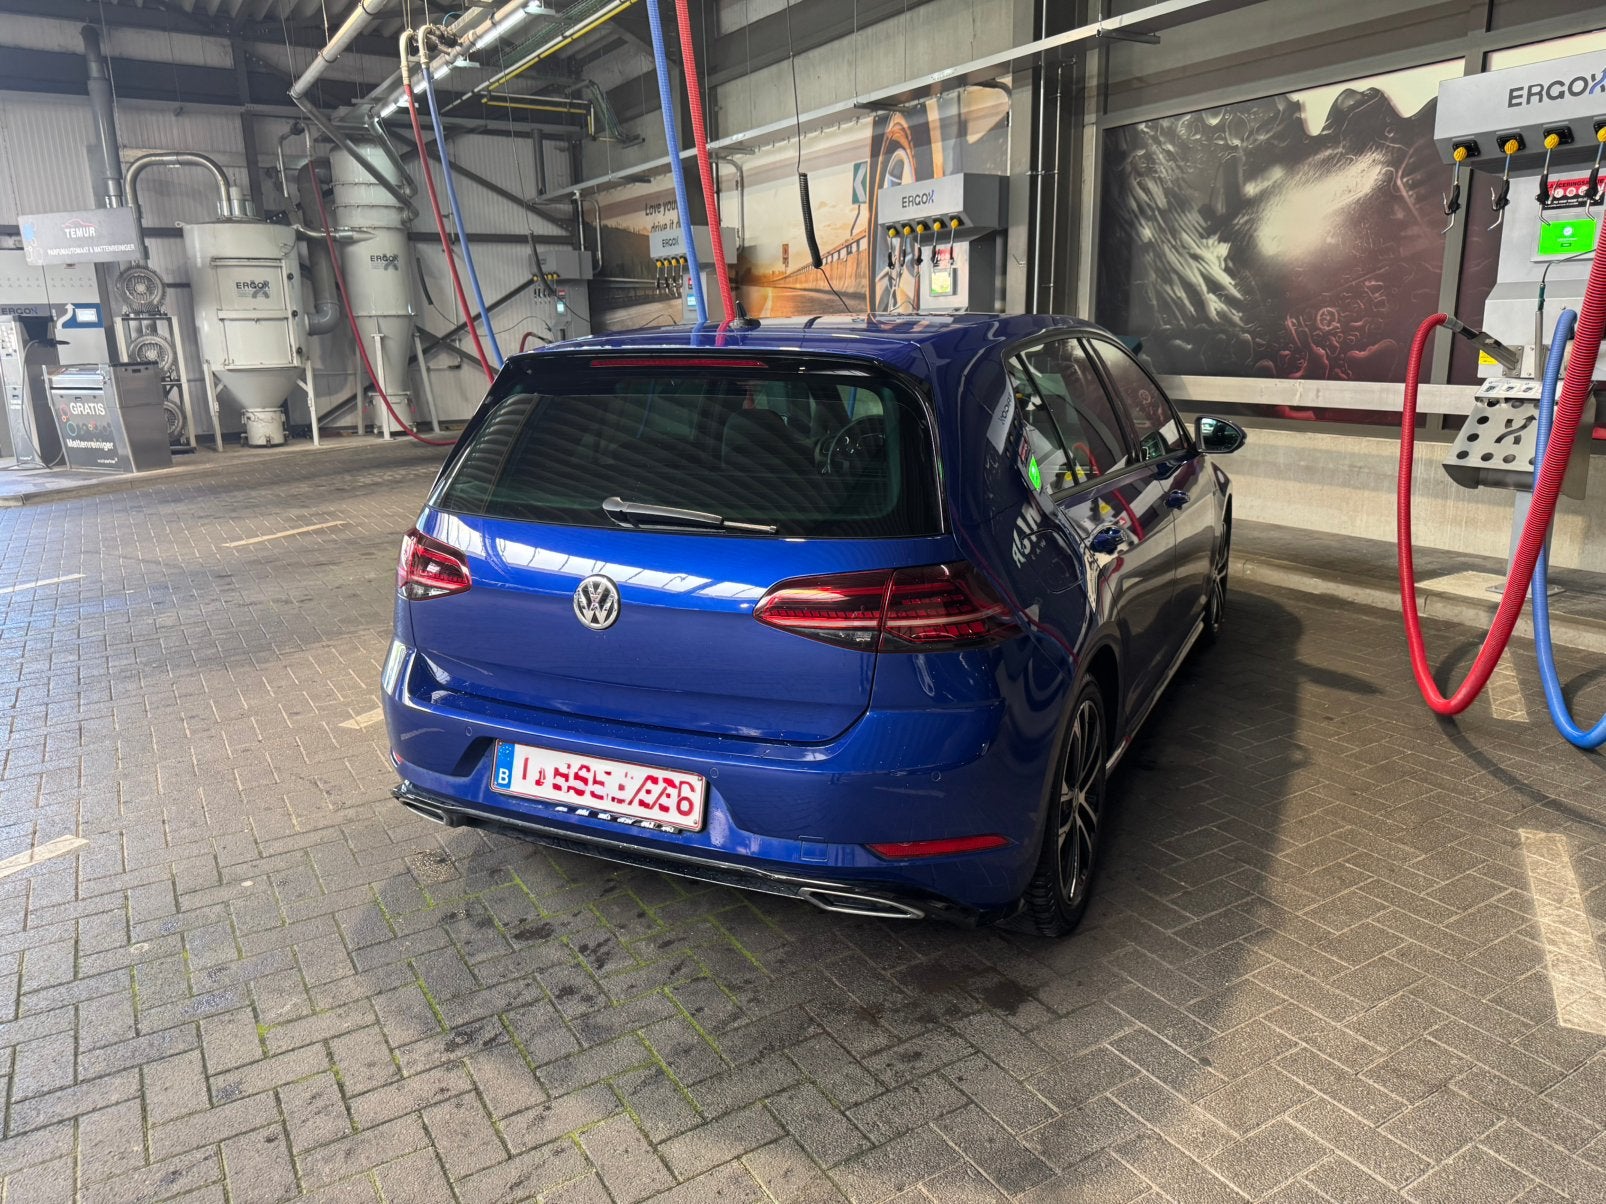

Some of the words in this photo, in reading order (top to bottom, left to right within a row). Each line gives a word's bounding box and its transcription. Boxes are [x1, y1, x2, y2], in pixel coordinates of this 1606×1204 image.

[901, 189, 935, 208] ERGOX
[645, 202, 661, 216] Love
[64, 227, 96, 239] TEMUR
[70, 402, 106, 416] GRATIS
[66, 438, 114, 451] Mattenreiniger
[498, 768, 509, 784] B
